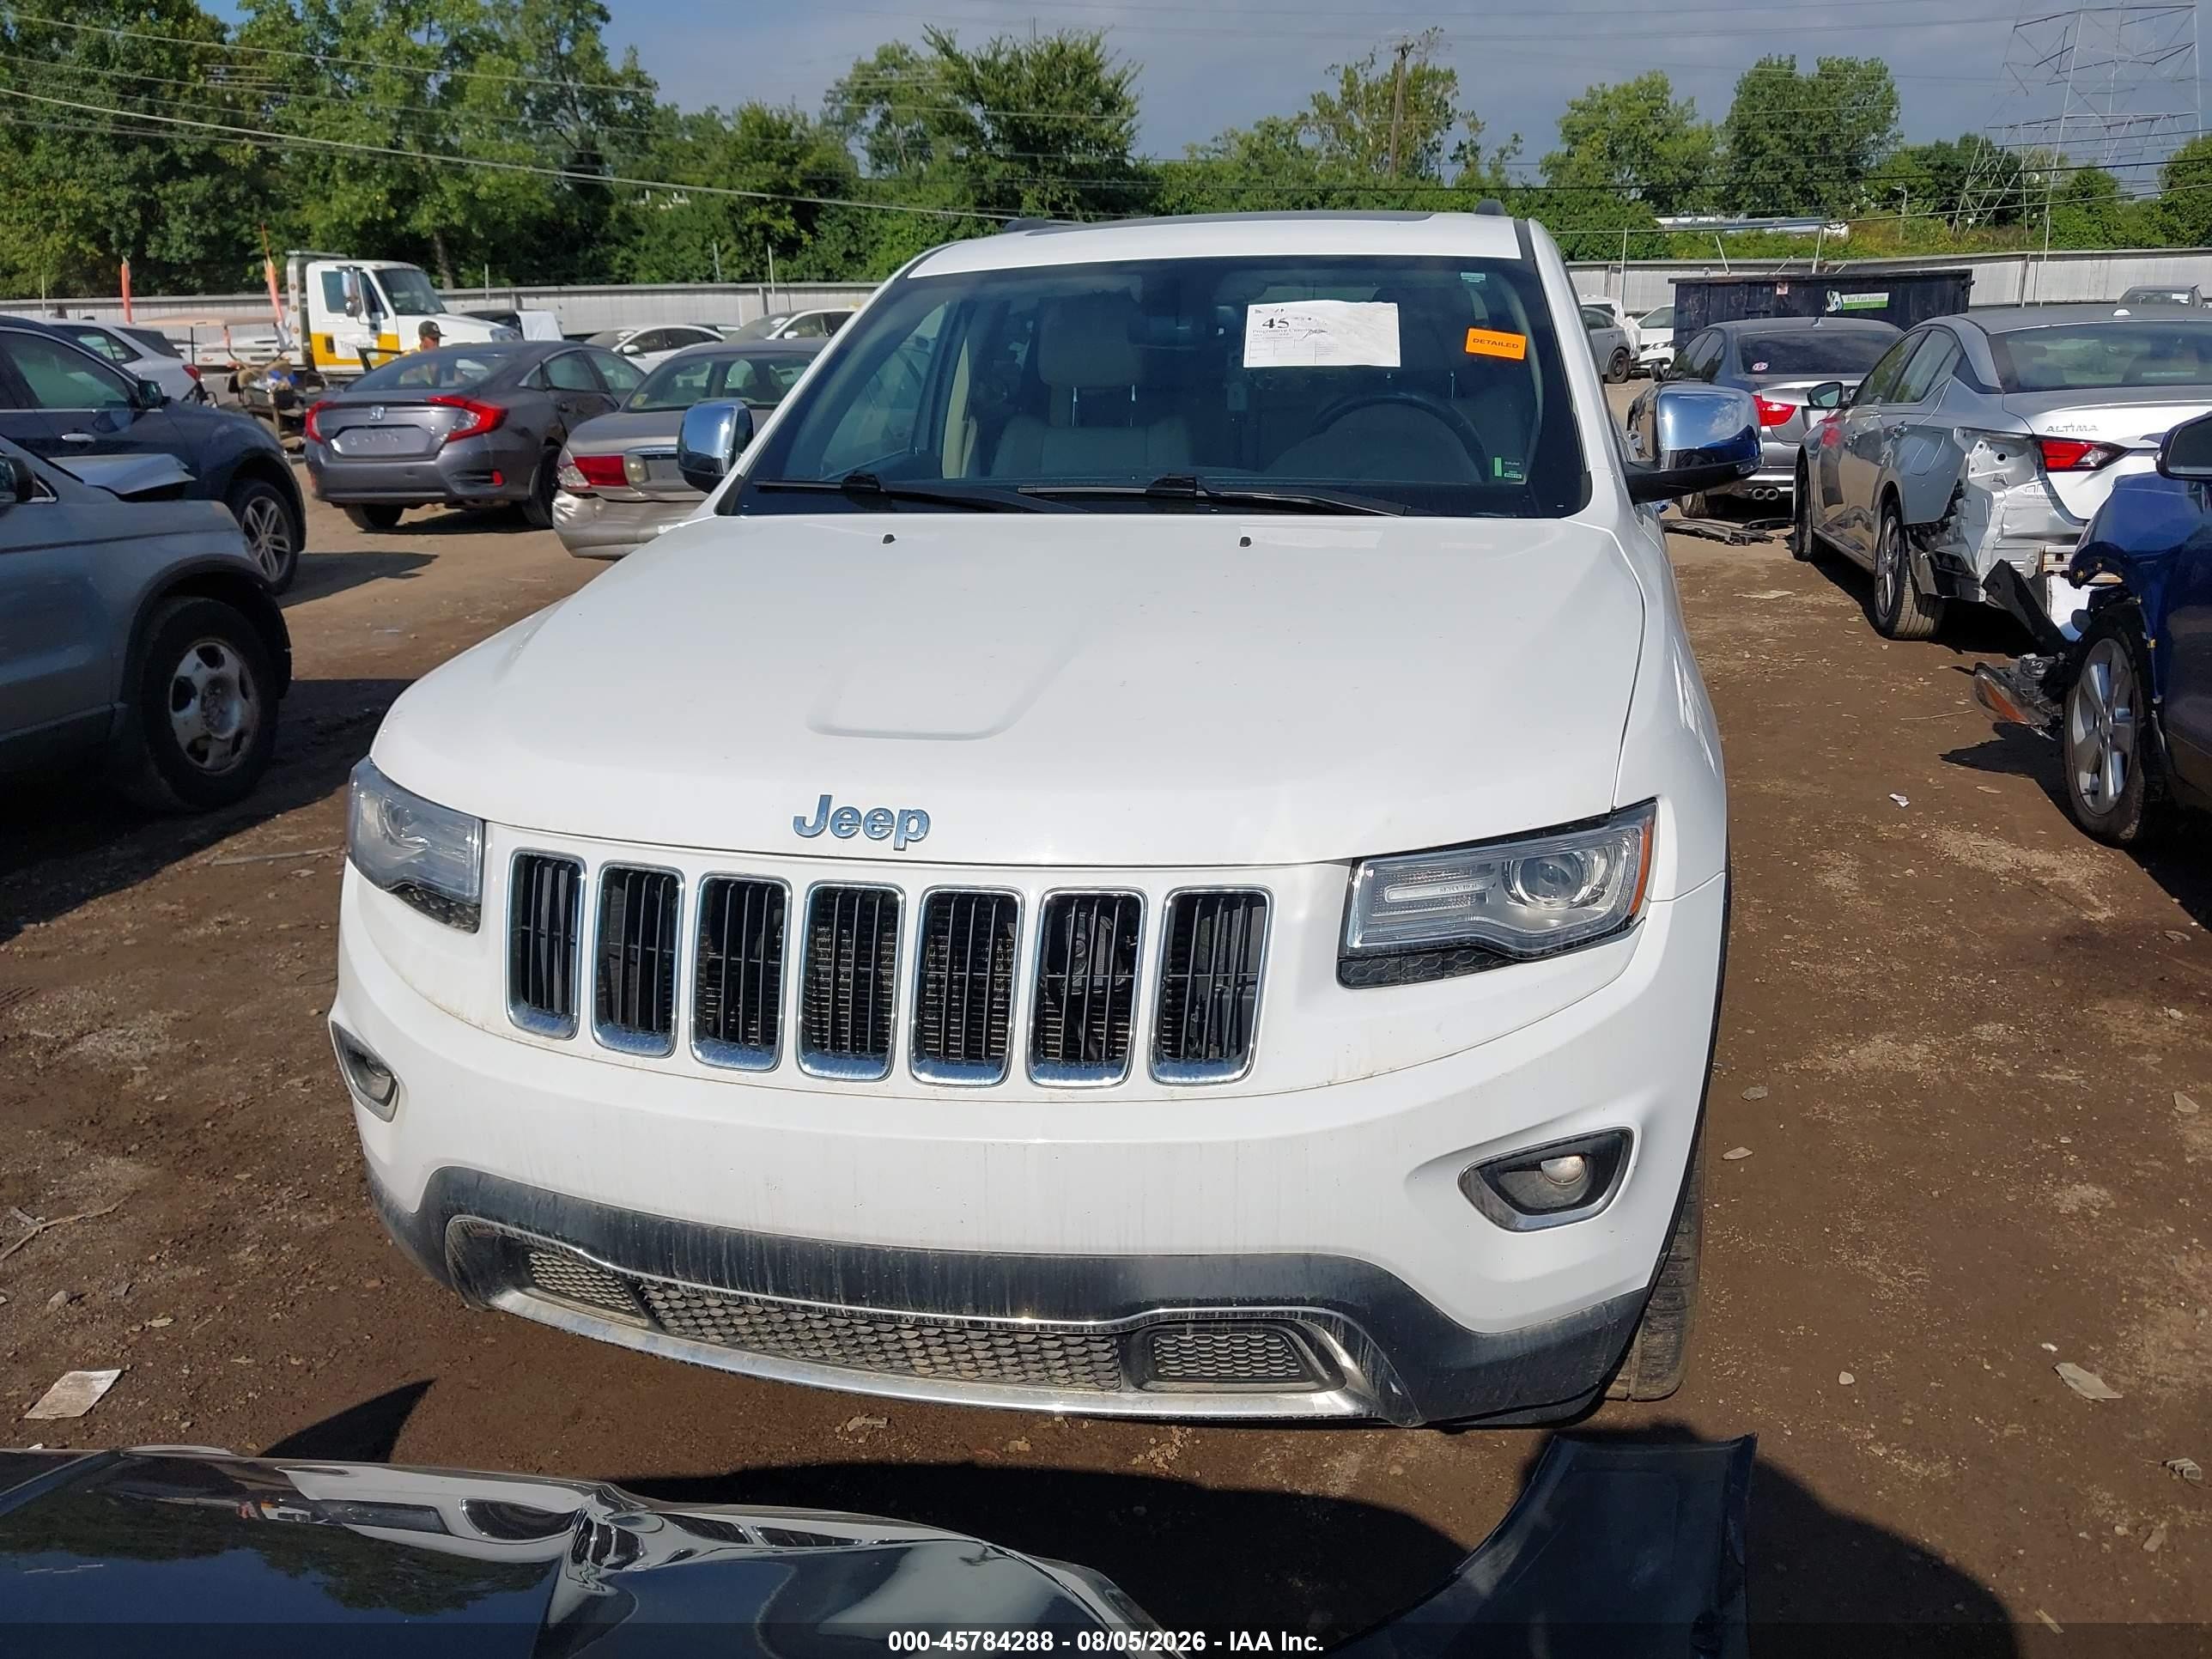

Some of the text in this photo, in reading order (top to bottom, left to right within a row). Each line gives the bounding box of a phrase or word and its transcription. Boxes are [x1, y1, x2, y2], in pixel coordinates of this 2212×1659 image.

[1261, 317, 1290, 329] 45
[1472, 337, 1519, 349] DETAILED
[2045, 423, 2099, 433] ALTIMA
[792, 793, 932, 852] Jeep
